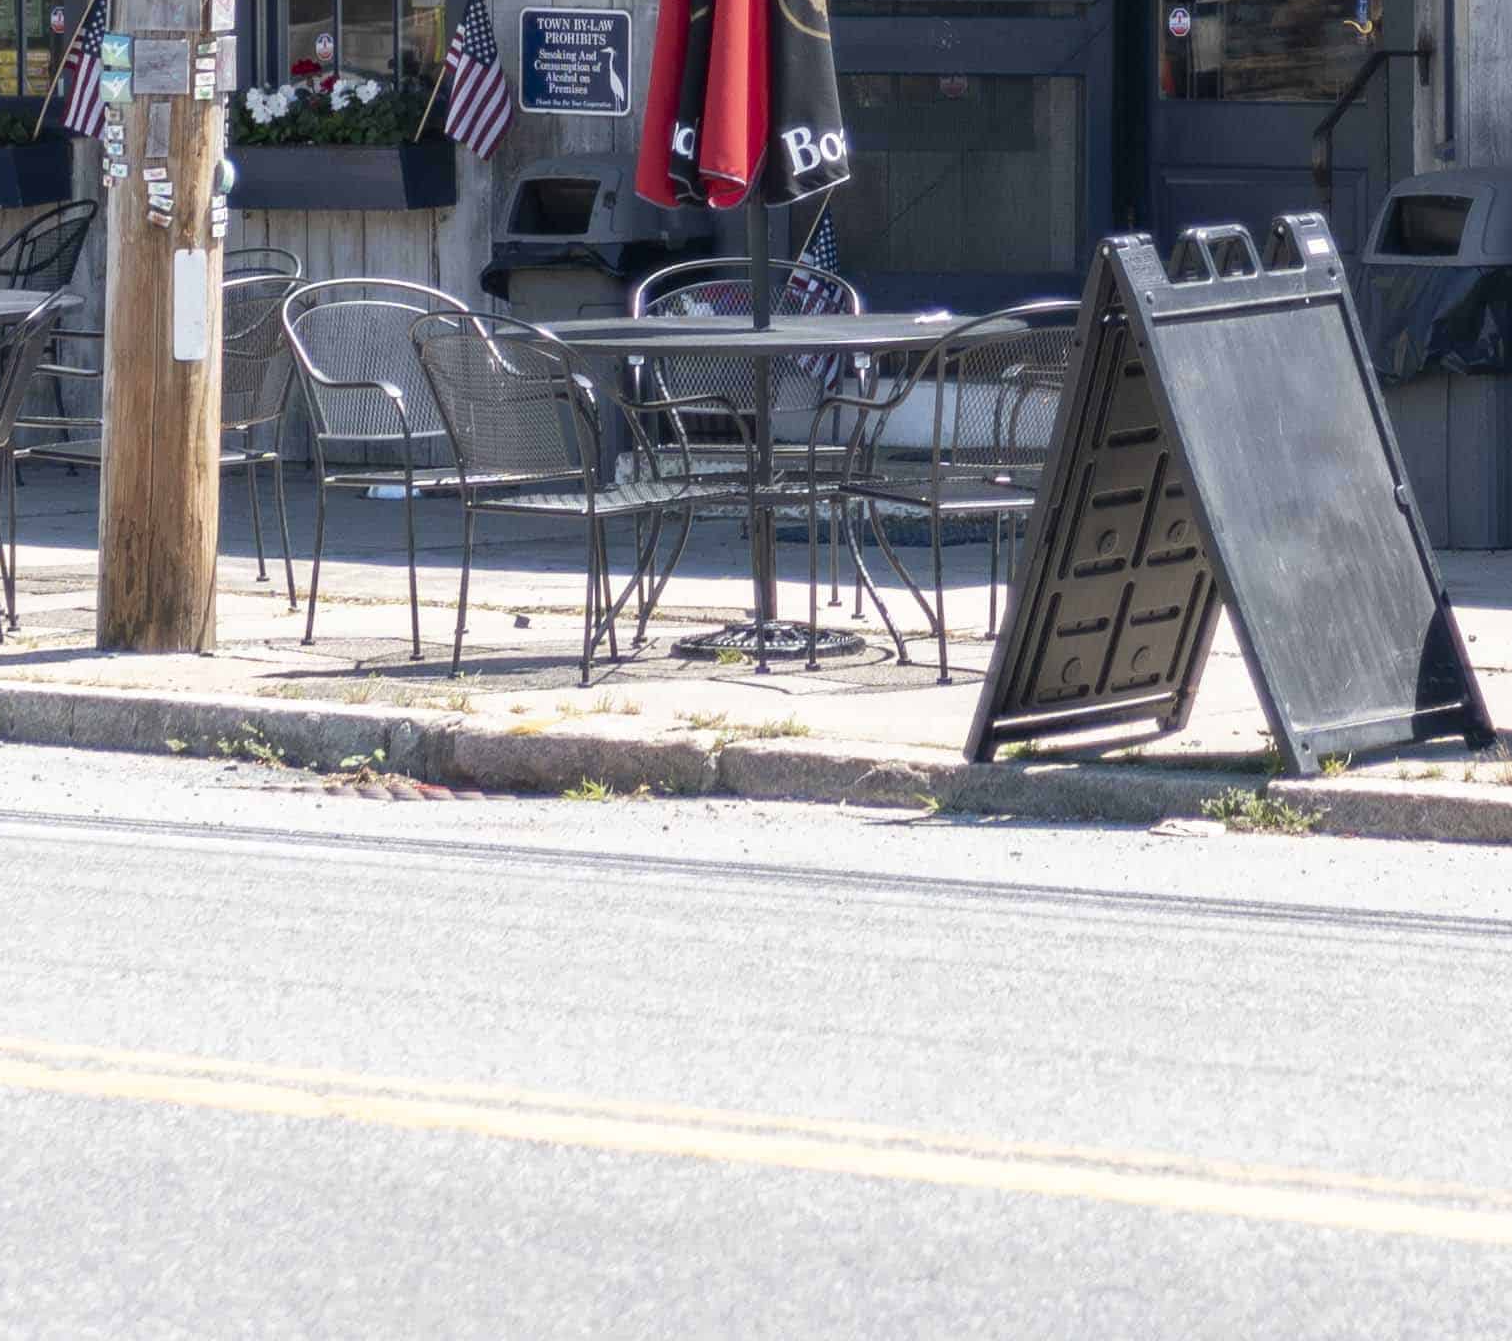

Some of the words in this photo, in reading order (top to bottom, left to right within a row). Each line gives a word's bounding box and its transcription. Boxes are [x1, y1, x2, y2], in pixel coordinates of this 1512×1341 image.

[537, 18, 570, 30] TOWN
[574, 19, 614, 31] BY-LAW
[545, 32, 606, 45] PROHIBITS
[539, 48, 576, 61] Smoking
[579, 50, 596, 61] And
[534, 60, 590, 73] Consumption
[592, 62, 602, 72] of
[546, 72, 577, 82] Alcohol
[579, 75, 590, 83] on
[549, 83, 587, 94] Premises
